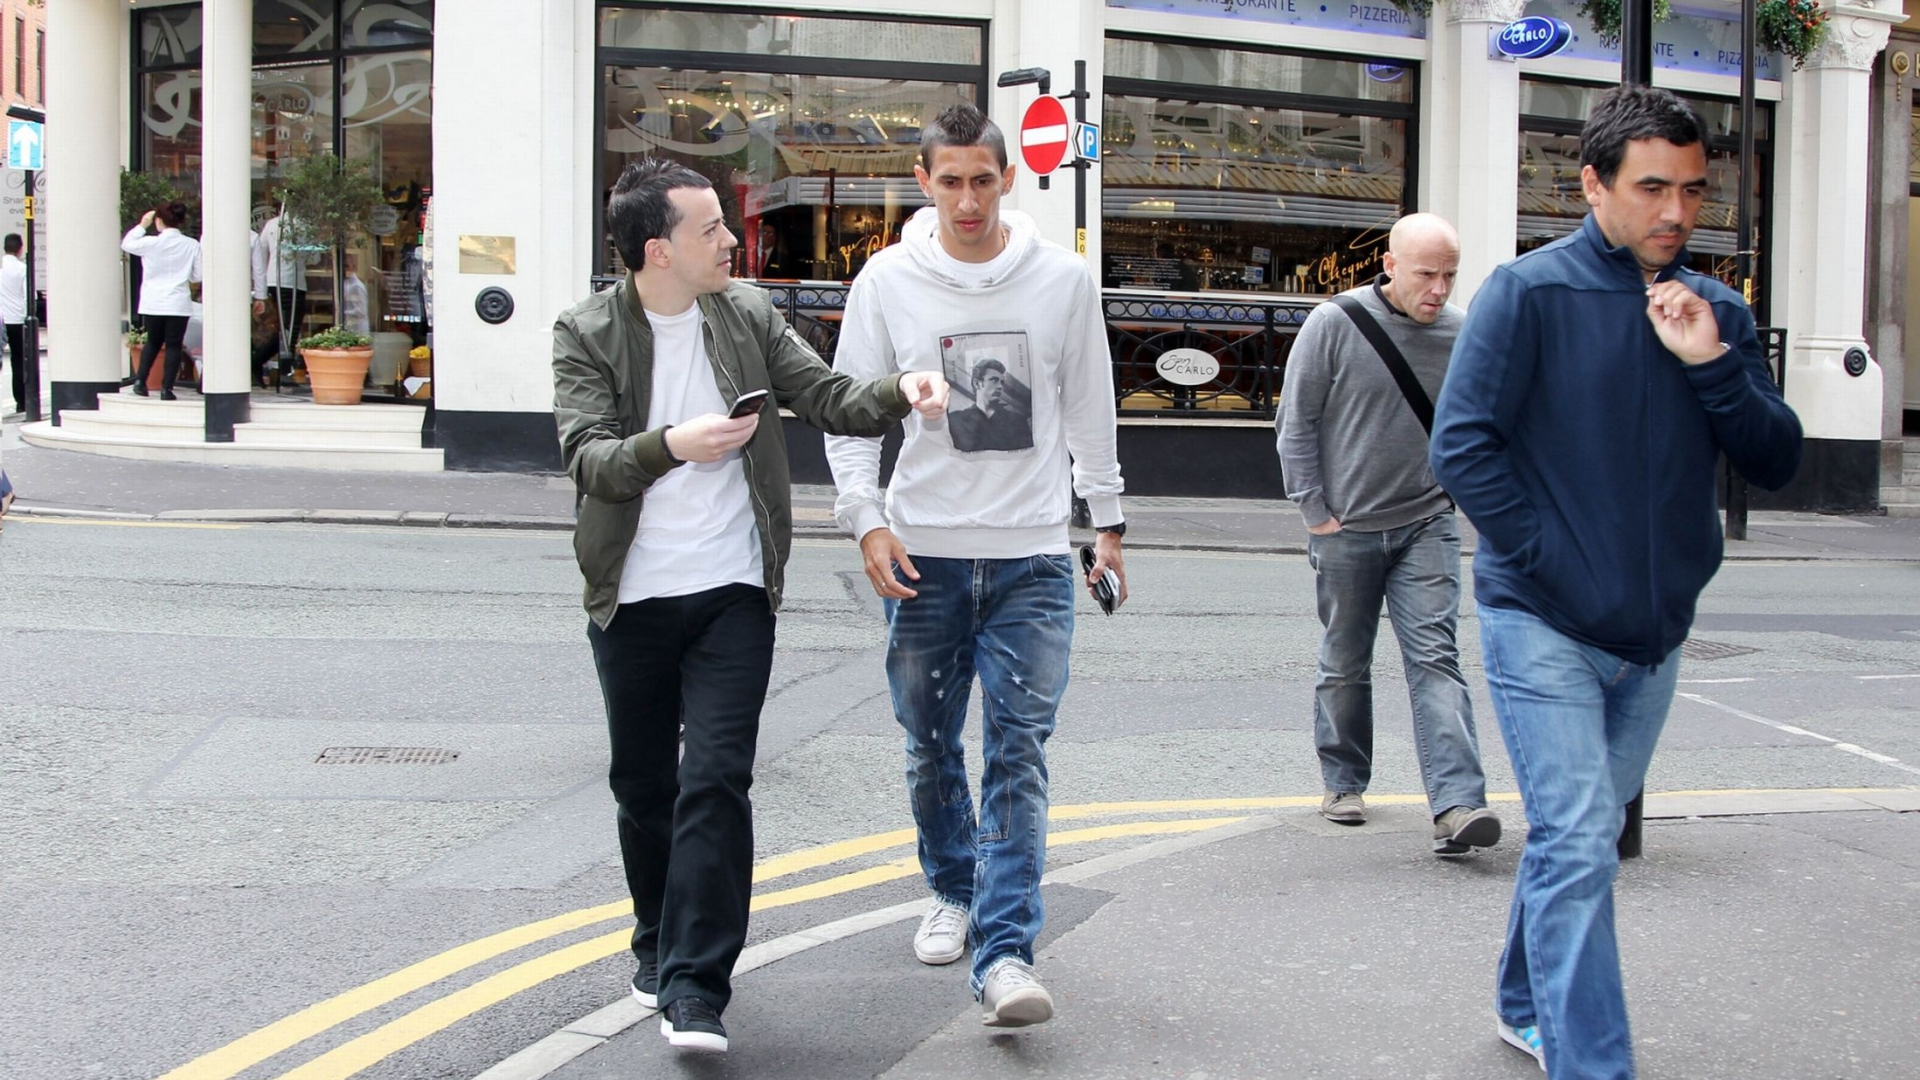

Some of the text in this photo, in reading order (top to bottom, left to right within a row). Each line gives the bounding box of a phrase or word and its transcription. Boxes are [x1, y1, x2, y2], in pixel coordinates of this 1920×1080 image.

[1350, 4, 1412, 25] PIZZERIA
[1511, 28, 1547, 44] CARLO
[267, 98, 307, 113] CARLO
[1086, 131, 1095, 153] P
[1176, 365, 1214, 376] CARLO
